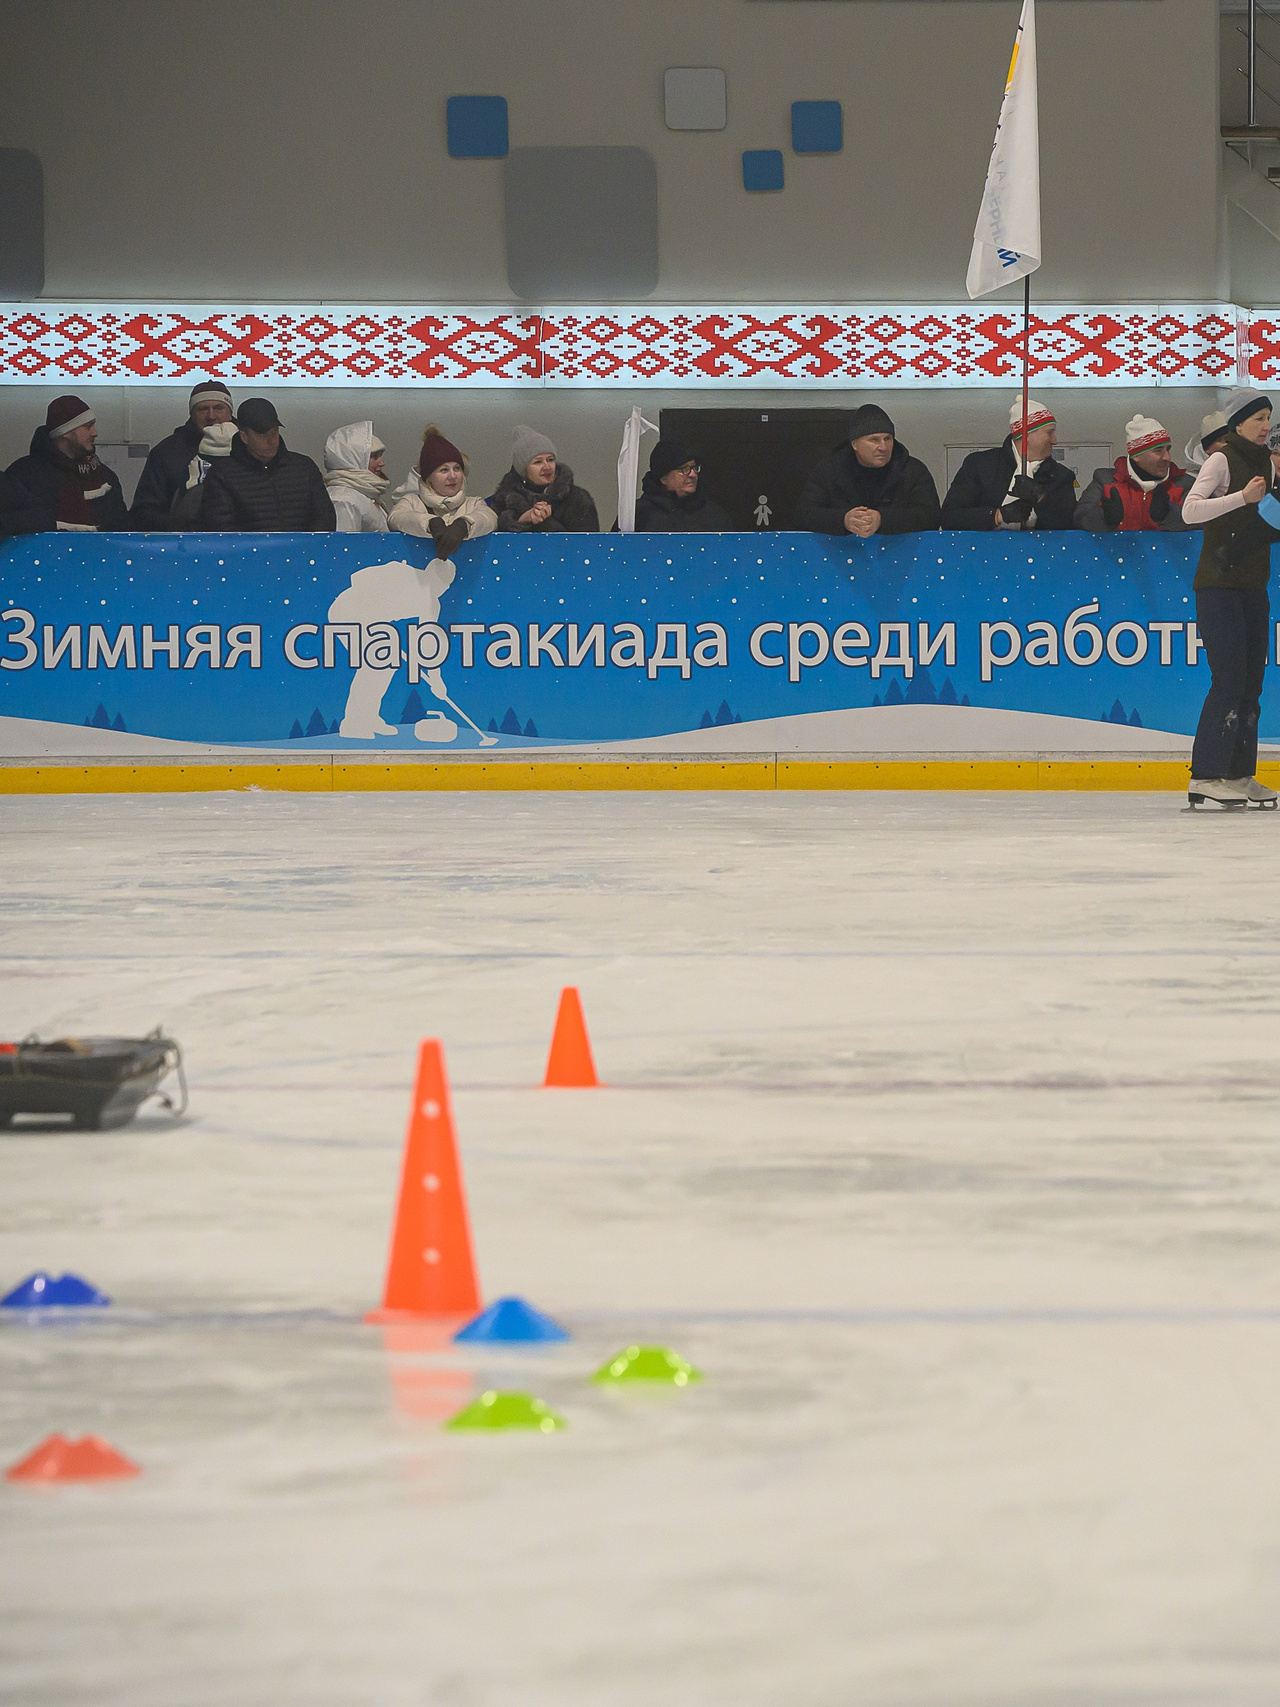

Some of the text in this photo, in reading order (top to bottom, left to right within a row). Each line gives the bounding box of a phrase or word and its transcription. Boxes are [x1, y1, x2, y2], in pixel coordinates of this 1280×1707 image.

[0, 608, 263, 670] Зимняя
[283, 620, 730, 684] спартакиада
[748, 619, 957, 683] среди
